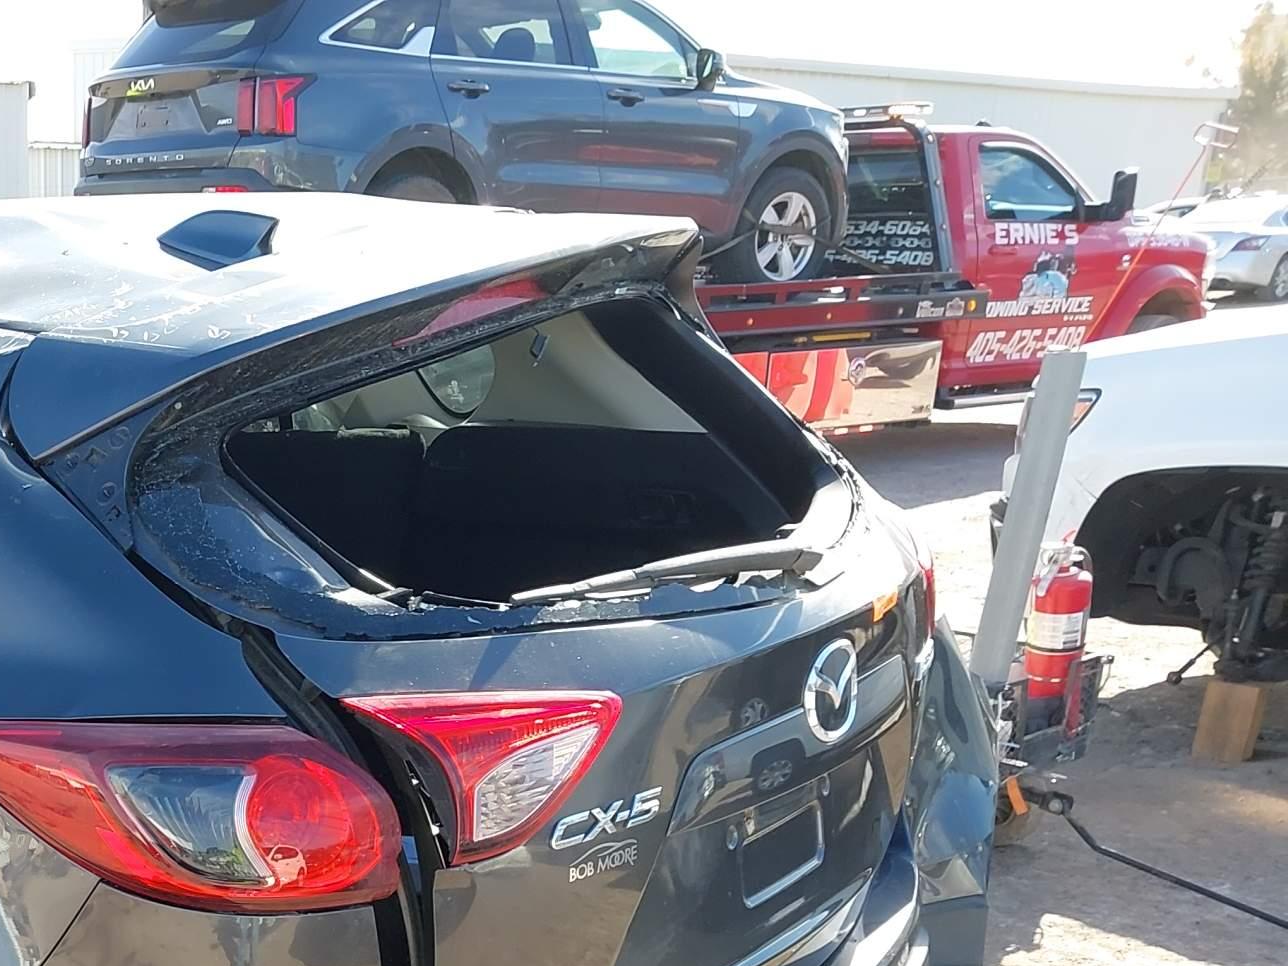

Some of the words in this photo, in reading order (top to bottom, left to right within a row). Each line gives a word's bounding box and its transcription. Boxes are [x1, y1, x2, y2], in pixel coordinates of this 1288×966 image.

[130, 78, 155, 91] KIA
[106, 154, 184, 166] SORENTO
[994, 222, 1079, 245] ERNIE'S
[1031, 296, 1093, 315] SERVICE
[551, 786, 663, 850] CX-5
[568, 861, 595, 883] BOB
[596, 844, 638, 874] MOORE
